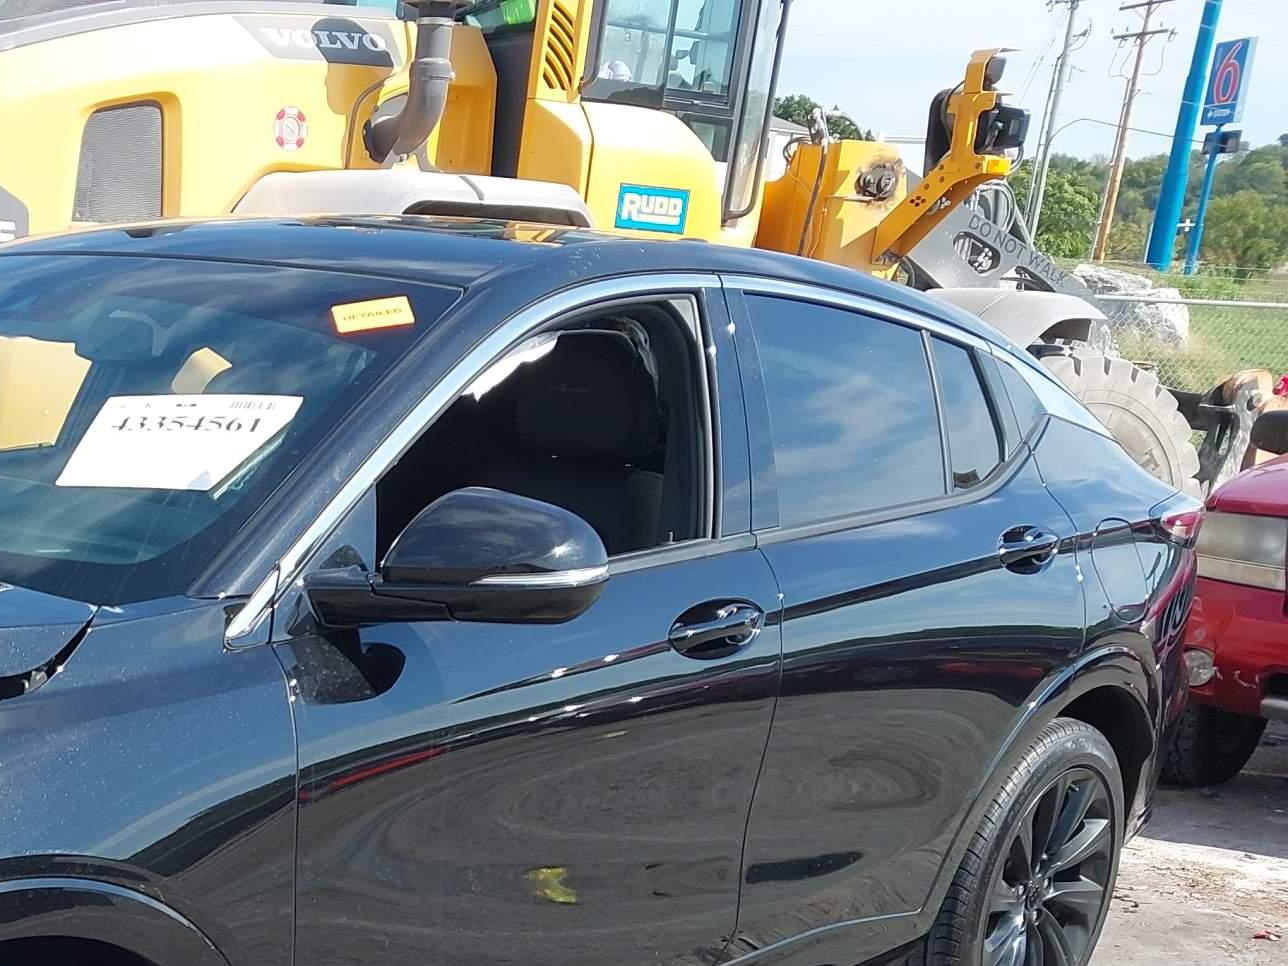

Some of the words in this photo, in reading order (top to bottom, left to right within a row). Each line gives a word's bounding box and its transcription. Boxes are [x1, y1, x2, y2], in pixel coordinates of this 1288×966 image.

[260, 27, 387, 52] VOLVO
[1213, 41, 1243, 104] 6
[620, 192, 684, 222] RUDD
[969, 214, 992, 238] DO
[993, 230, 1028, 260] NOT
[1028, 251, 1065, 285] WALK
[111, 415, 262, 433] 43354561
